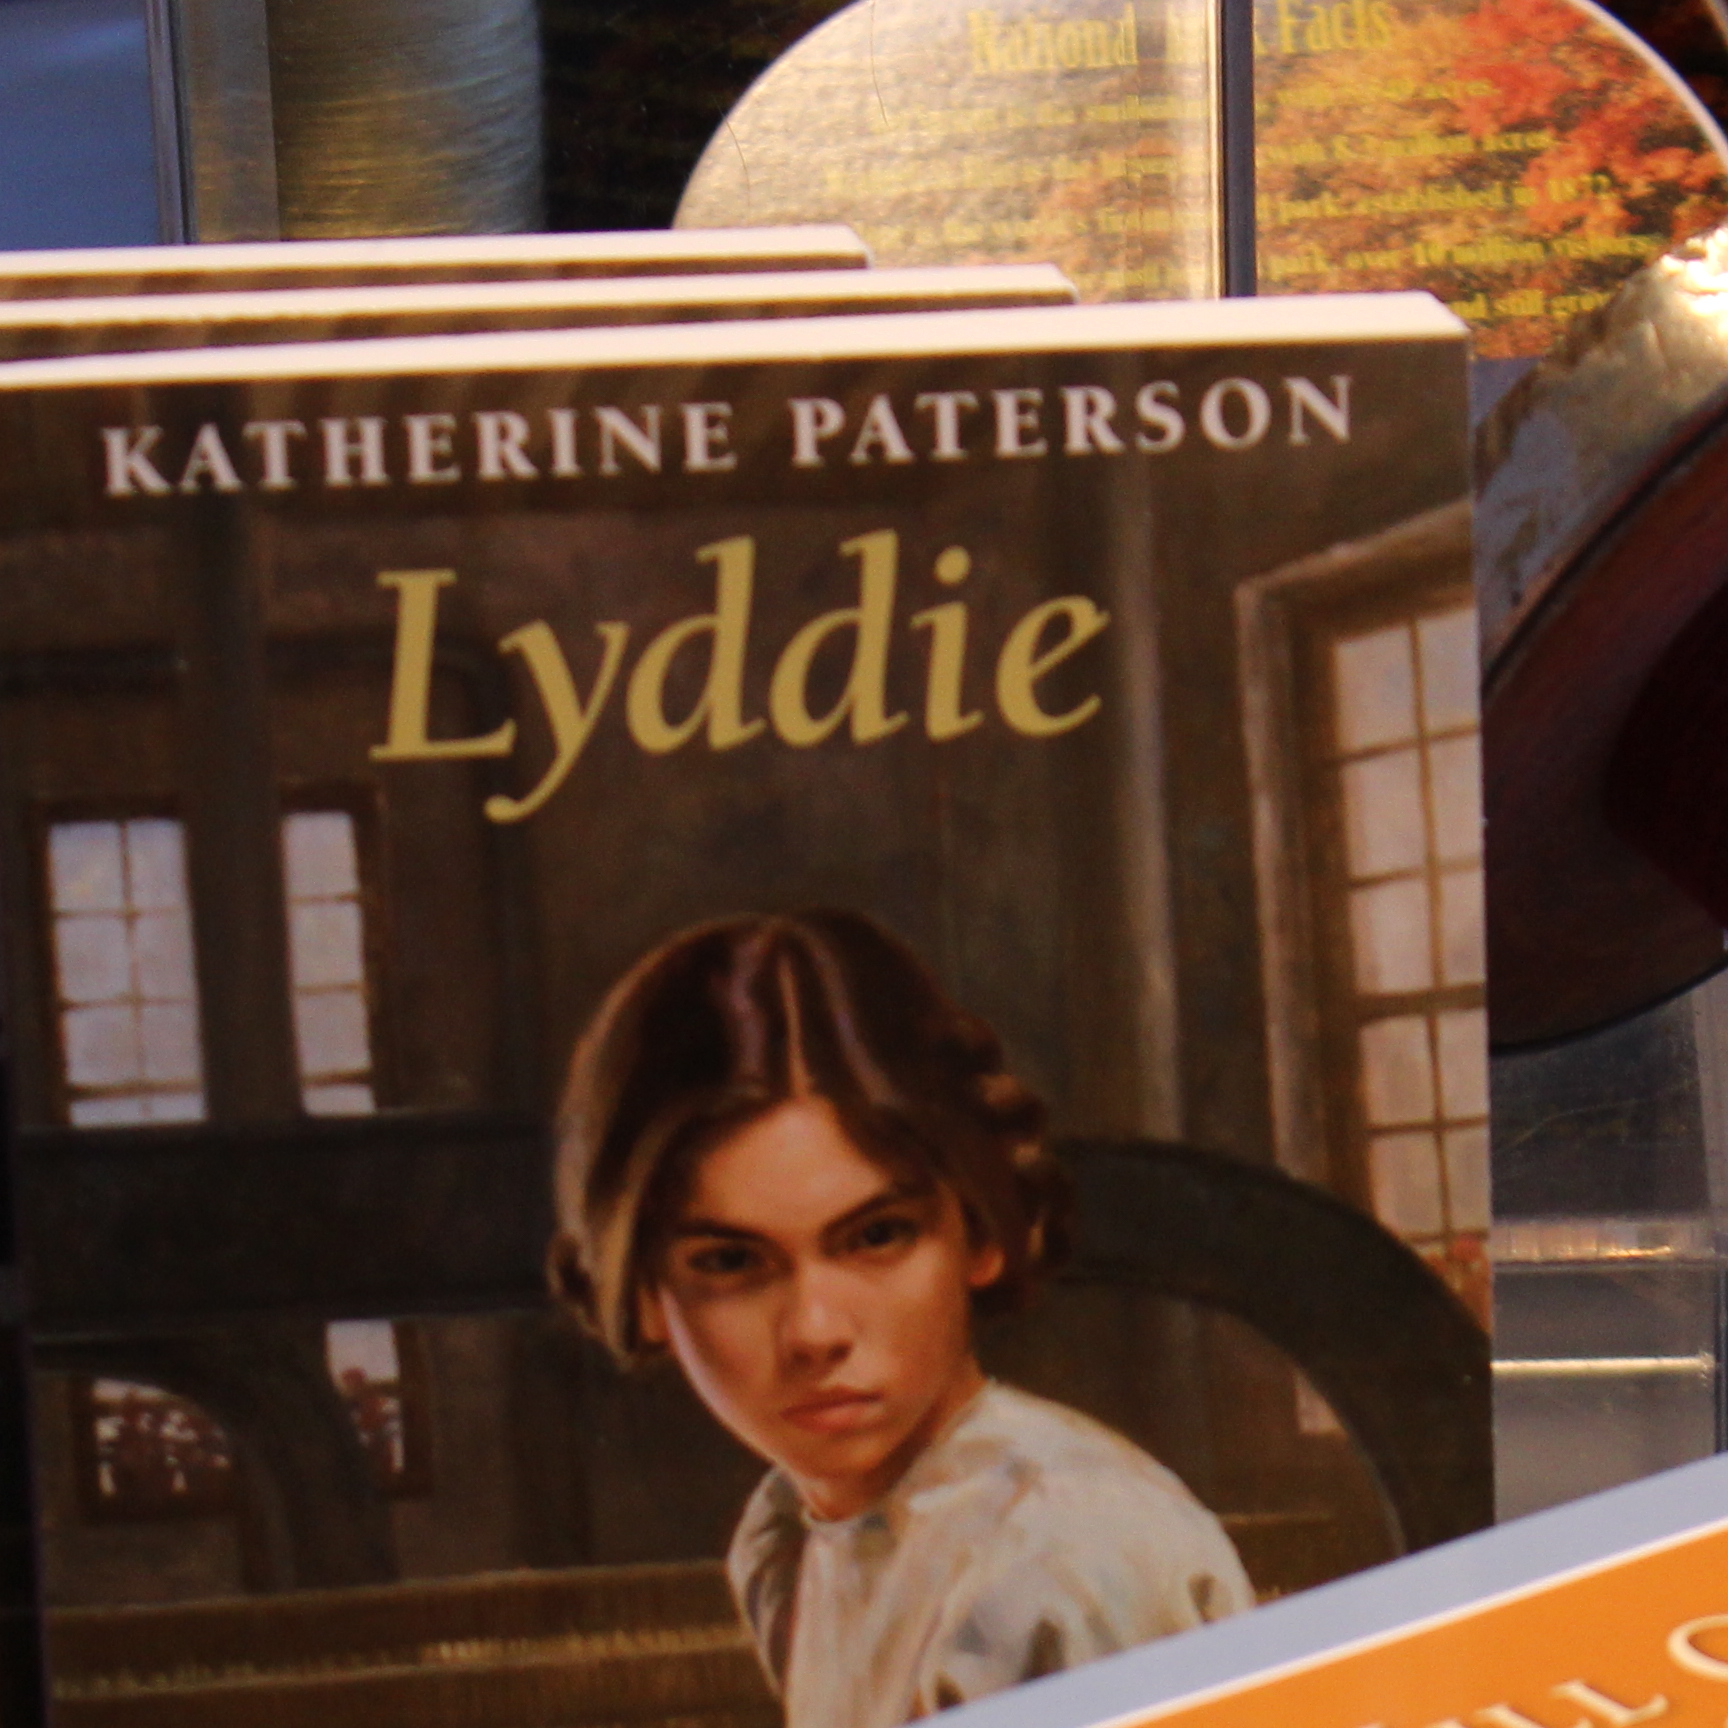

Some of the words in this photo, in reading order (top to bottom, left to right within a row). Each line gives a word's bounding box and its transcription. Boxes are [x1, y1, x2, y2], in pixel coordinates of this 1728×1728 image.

[101, 402, 737, 497] KATHERINE
[791, 372, 1357, 469] PATERSON
[369, 527, 1112, 823] Lyddie
